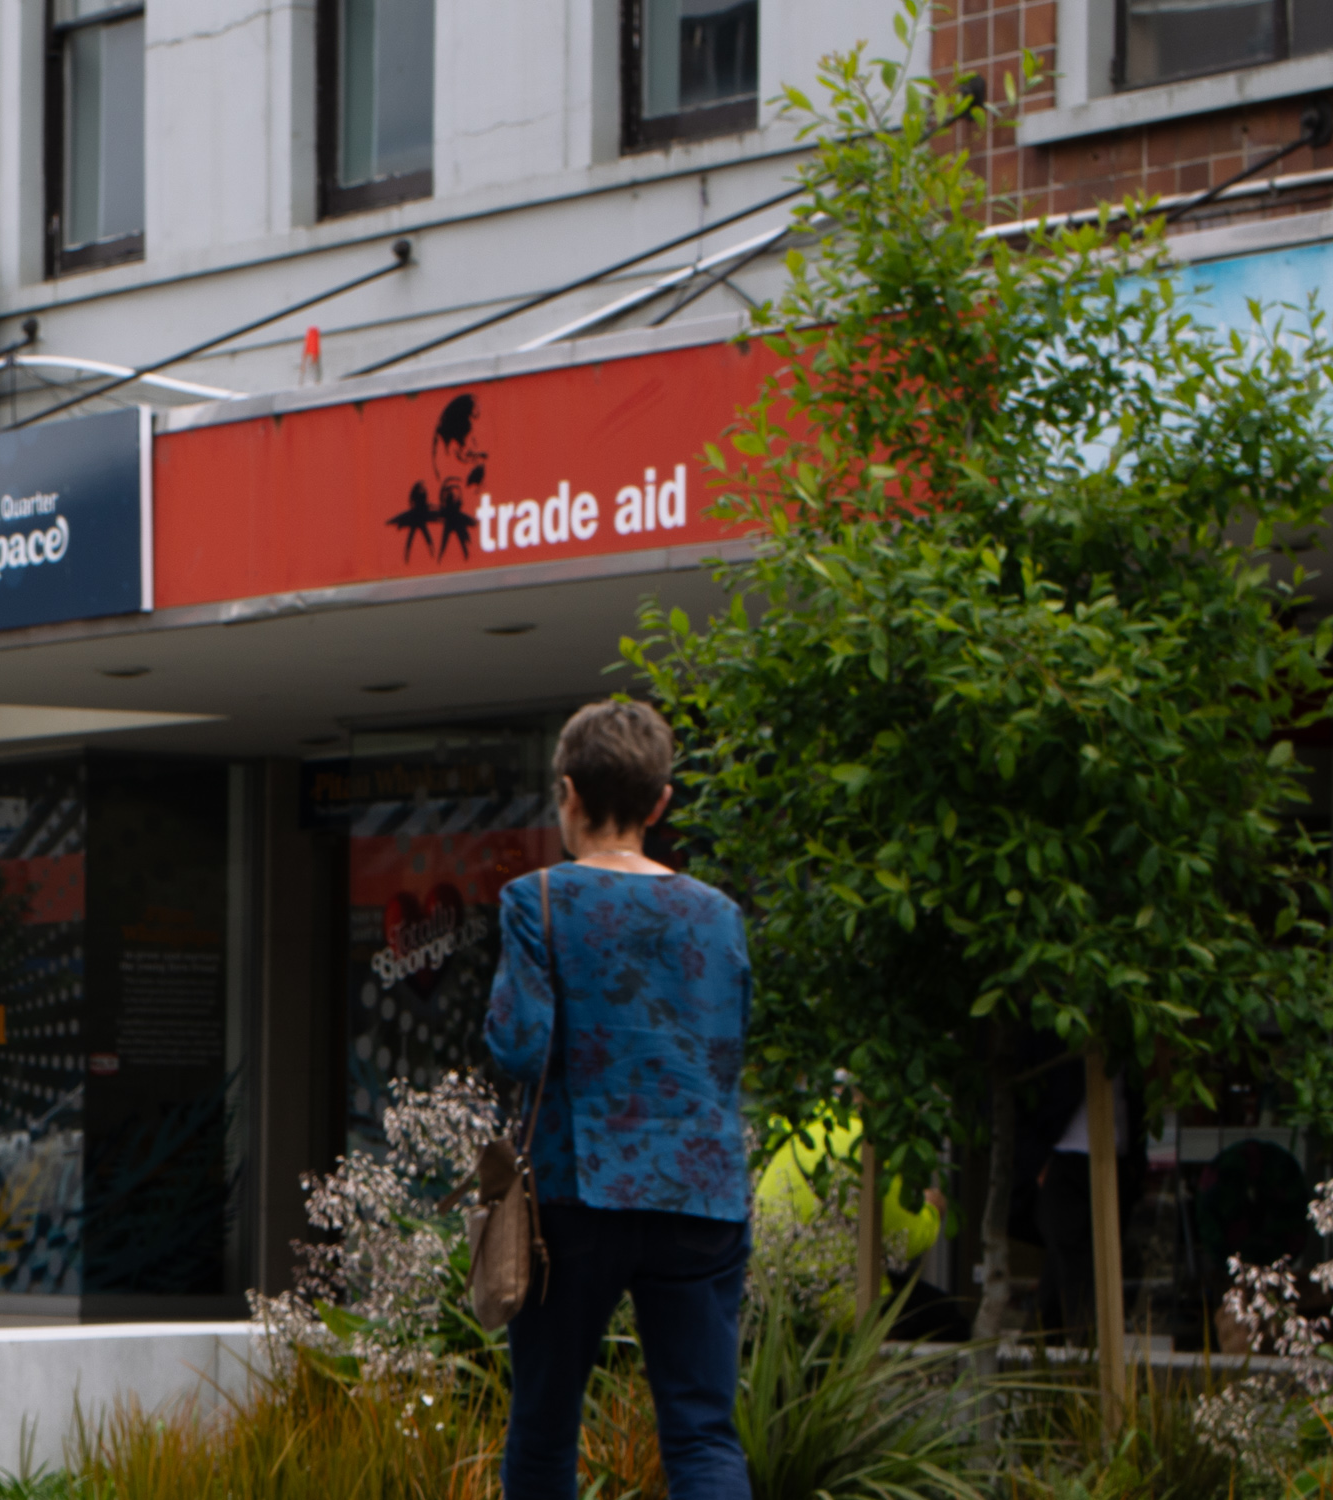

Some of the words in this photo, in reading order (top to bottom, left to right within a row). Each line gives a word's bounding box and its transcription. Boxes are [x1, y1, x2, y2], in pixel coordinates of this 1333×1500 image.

[0, 490, 60, 522] Quarter
[475, 478, 599, 553] trade
[614, 463, 687, 536] aid
